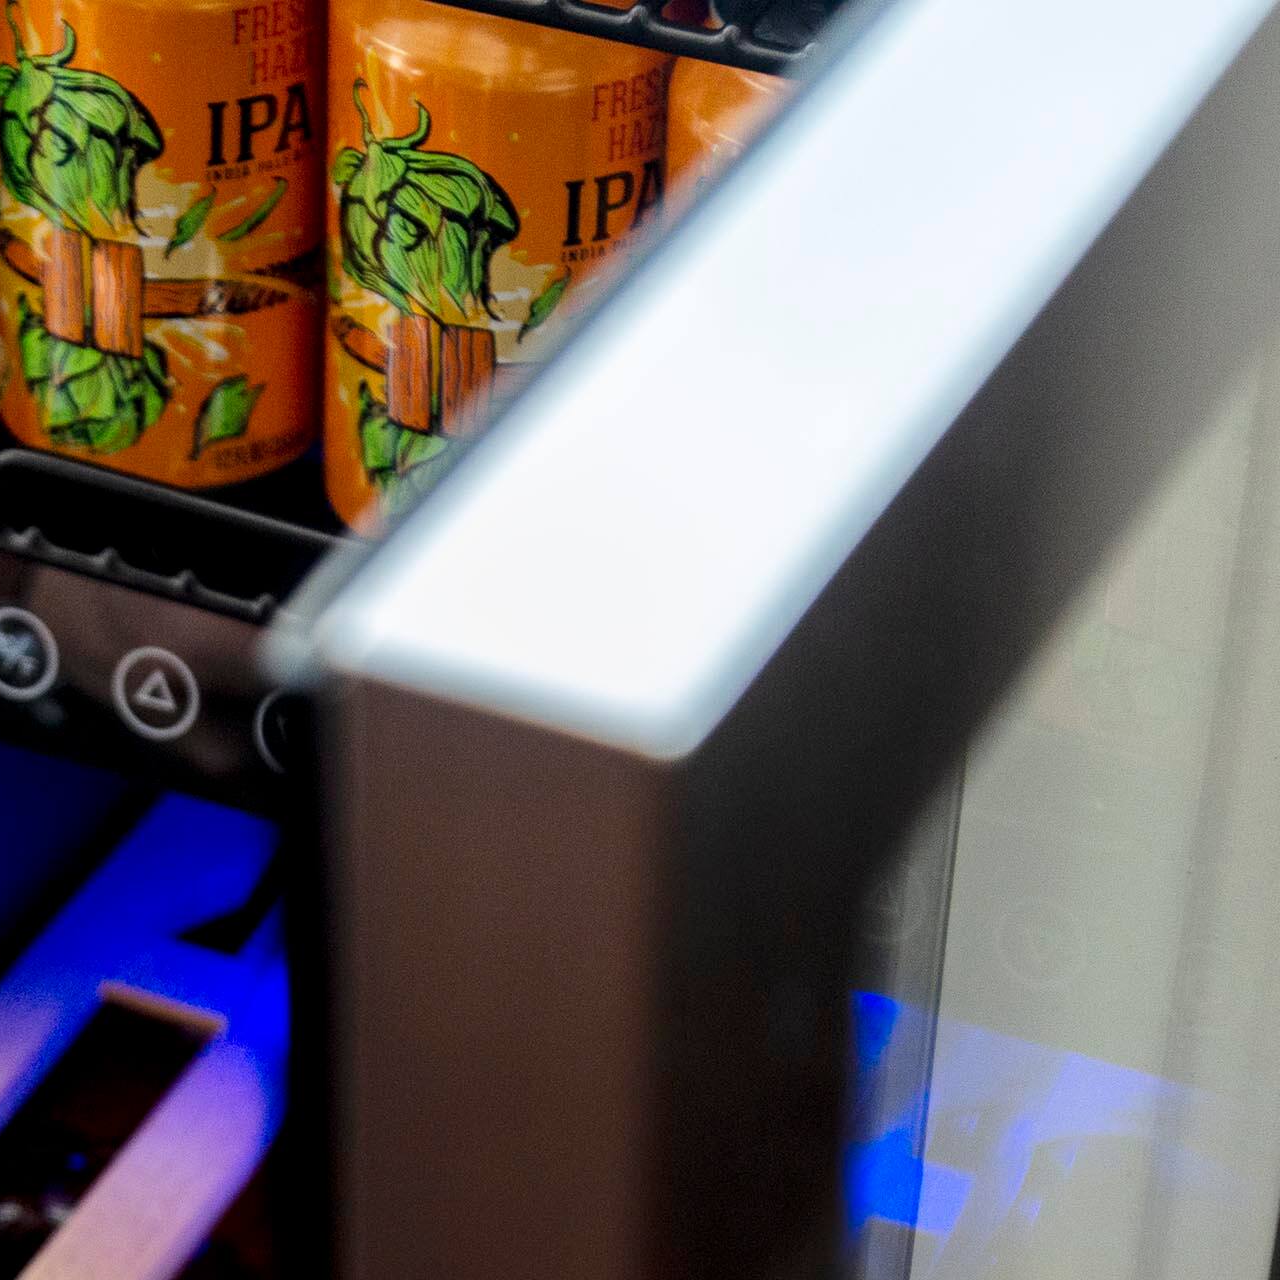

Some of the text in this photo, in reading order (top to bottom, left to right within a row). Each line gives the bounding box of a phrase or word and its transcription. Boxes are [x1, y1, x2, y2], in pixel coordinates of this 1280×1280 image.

[231, 0, 303, 46] FRES
[591, 67, 663, 122] FRES
[207, 83, 312, 167] IPA
[608, 112, 663, 162] HAZ
[562, 159, 665, 247] IPA
